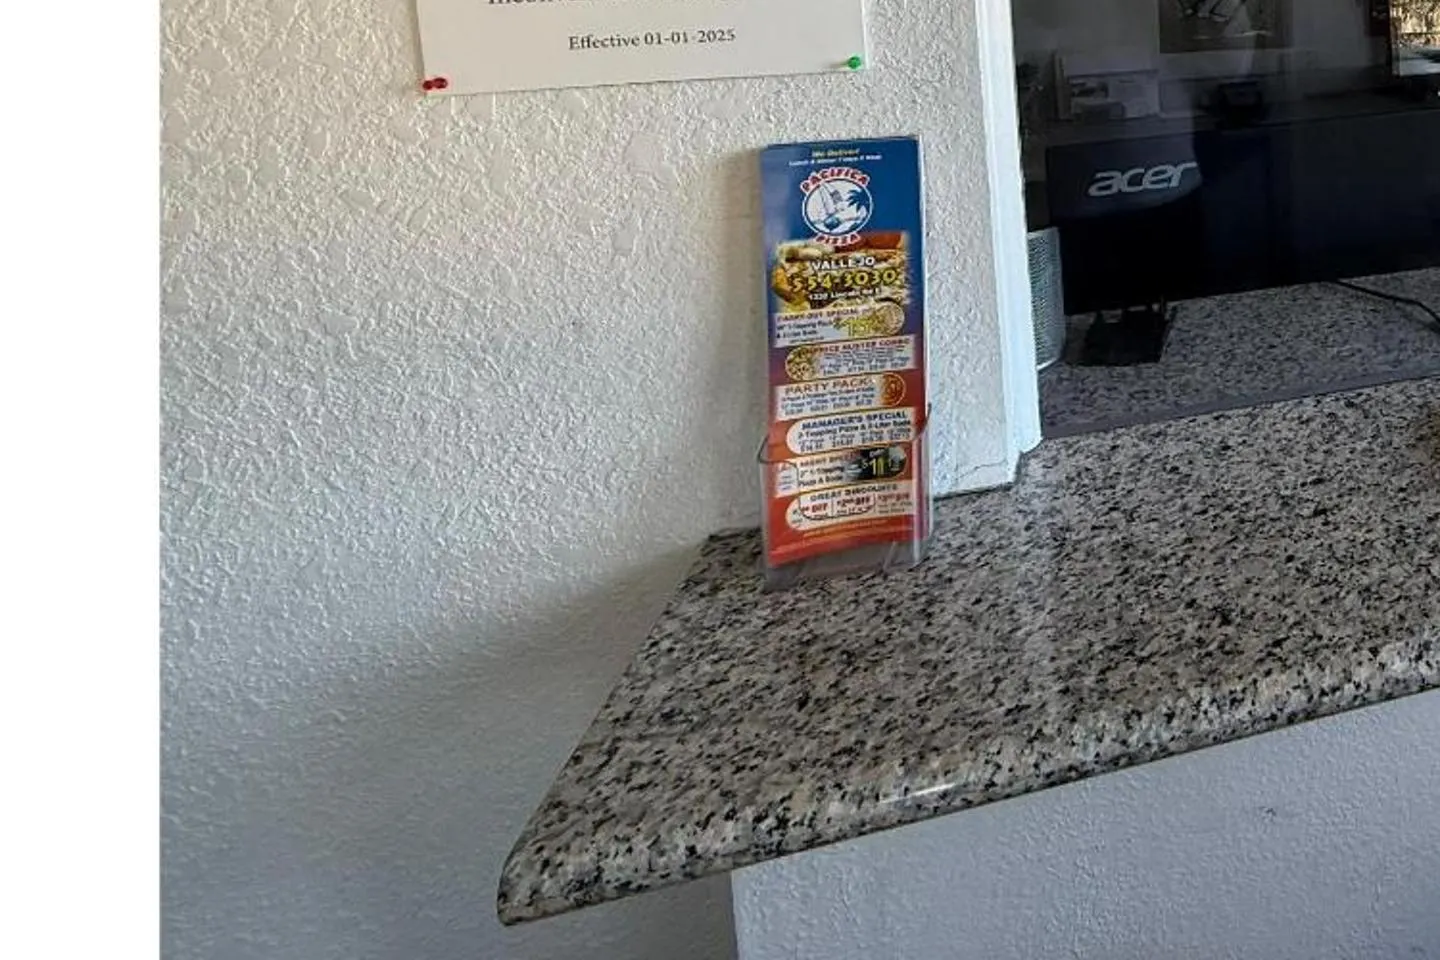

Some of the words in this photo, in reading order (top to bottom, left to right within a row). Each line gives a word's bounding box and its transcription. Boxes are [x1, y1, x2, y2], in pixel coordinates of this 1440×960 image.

[568, 34, 640, 50] Effective
[644, 29, 736, 45] 01-01-2025
[801, 168, 869, 191] PACIFICA
[1088, 161, 1198, 197] acer
[812, 256, 875, 270] VALLEJO
[792, 268, 896, 291] 554-3030
[785, 382, 828, 394] PARTY
[801, 416, 863, 430] MANAGER'S
[866, 411, 906, 421] SPECIAL
